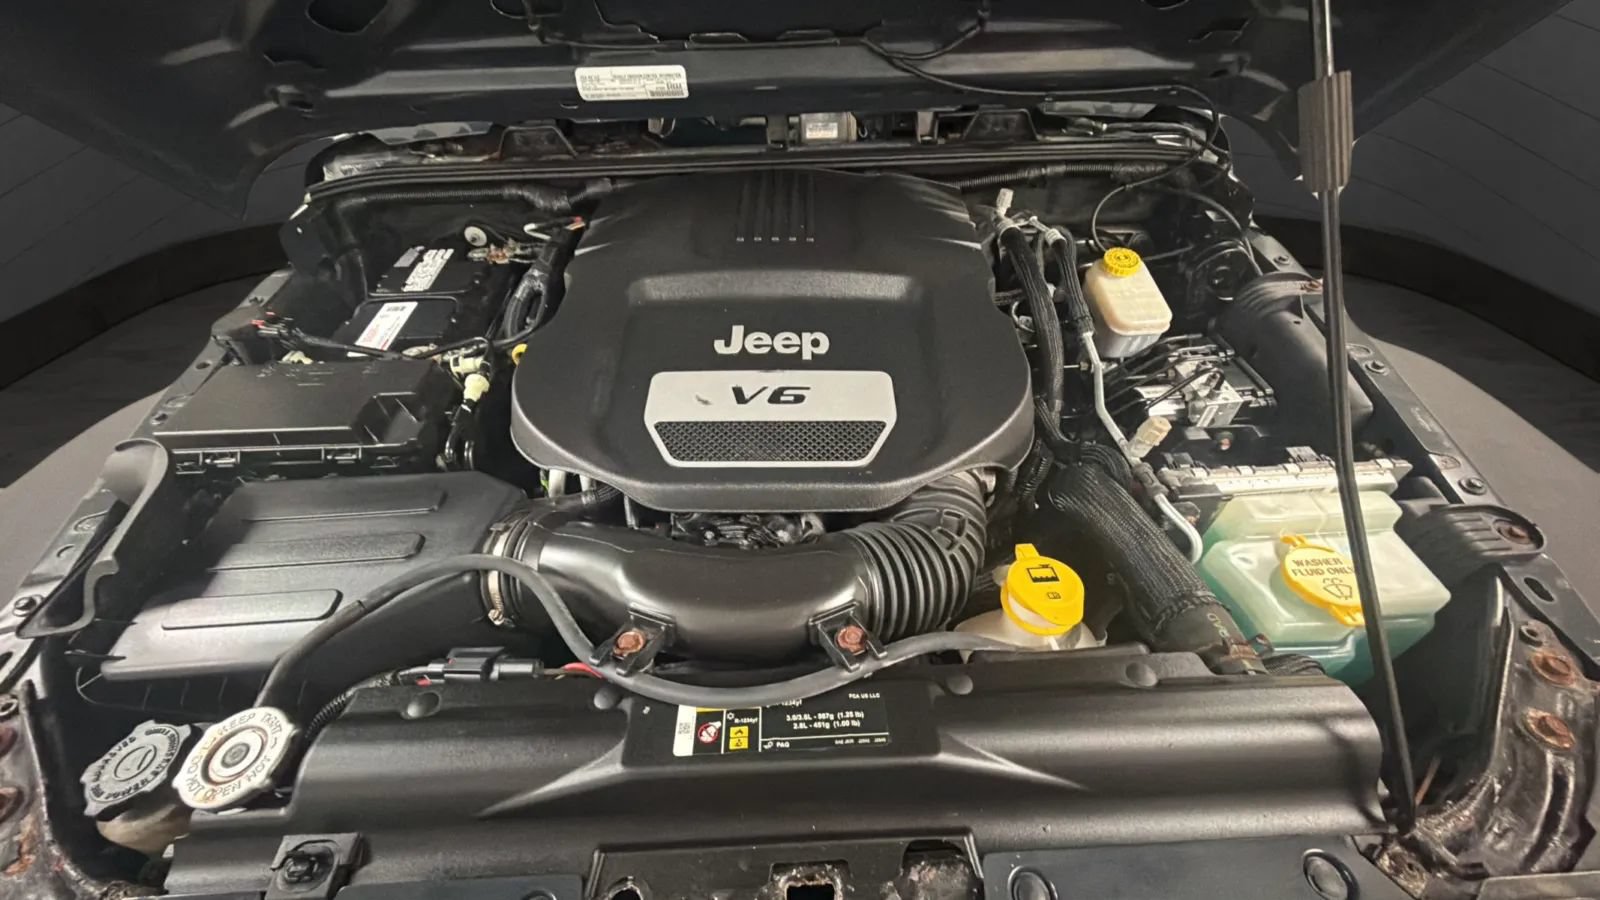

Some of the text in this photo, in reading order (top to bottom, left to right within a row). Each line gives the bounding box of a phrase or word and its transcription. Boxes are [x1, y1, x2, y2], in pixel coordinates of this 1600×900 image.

[713, 325, 829, 360] Jeep
[731, 385, 811, 404] V6
[1291, 558, 1344, 567] WASHER
[1291, 568, 1325, 577] FLUID
